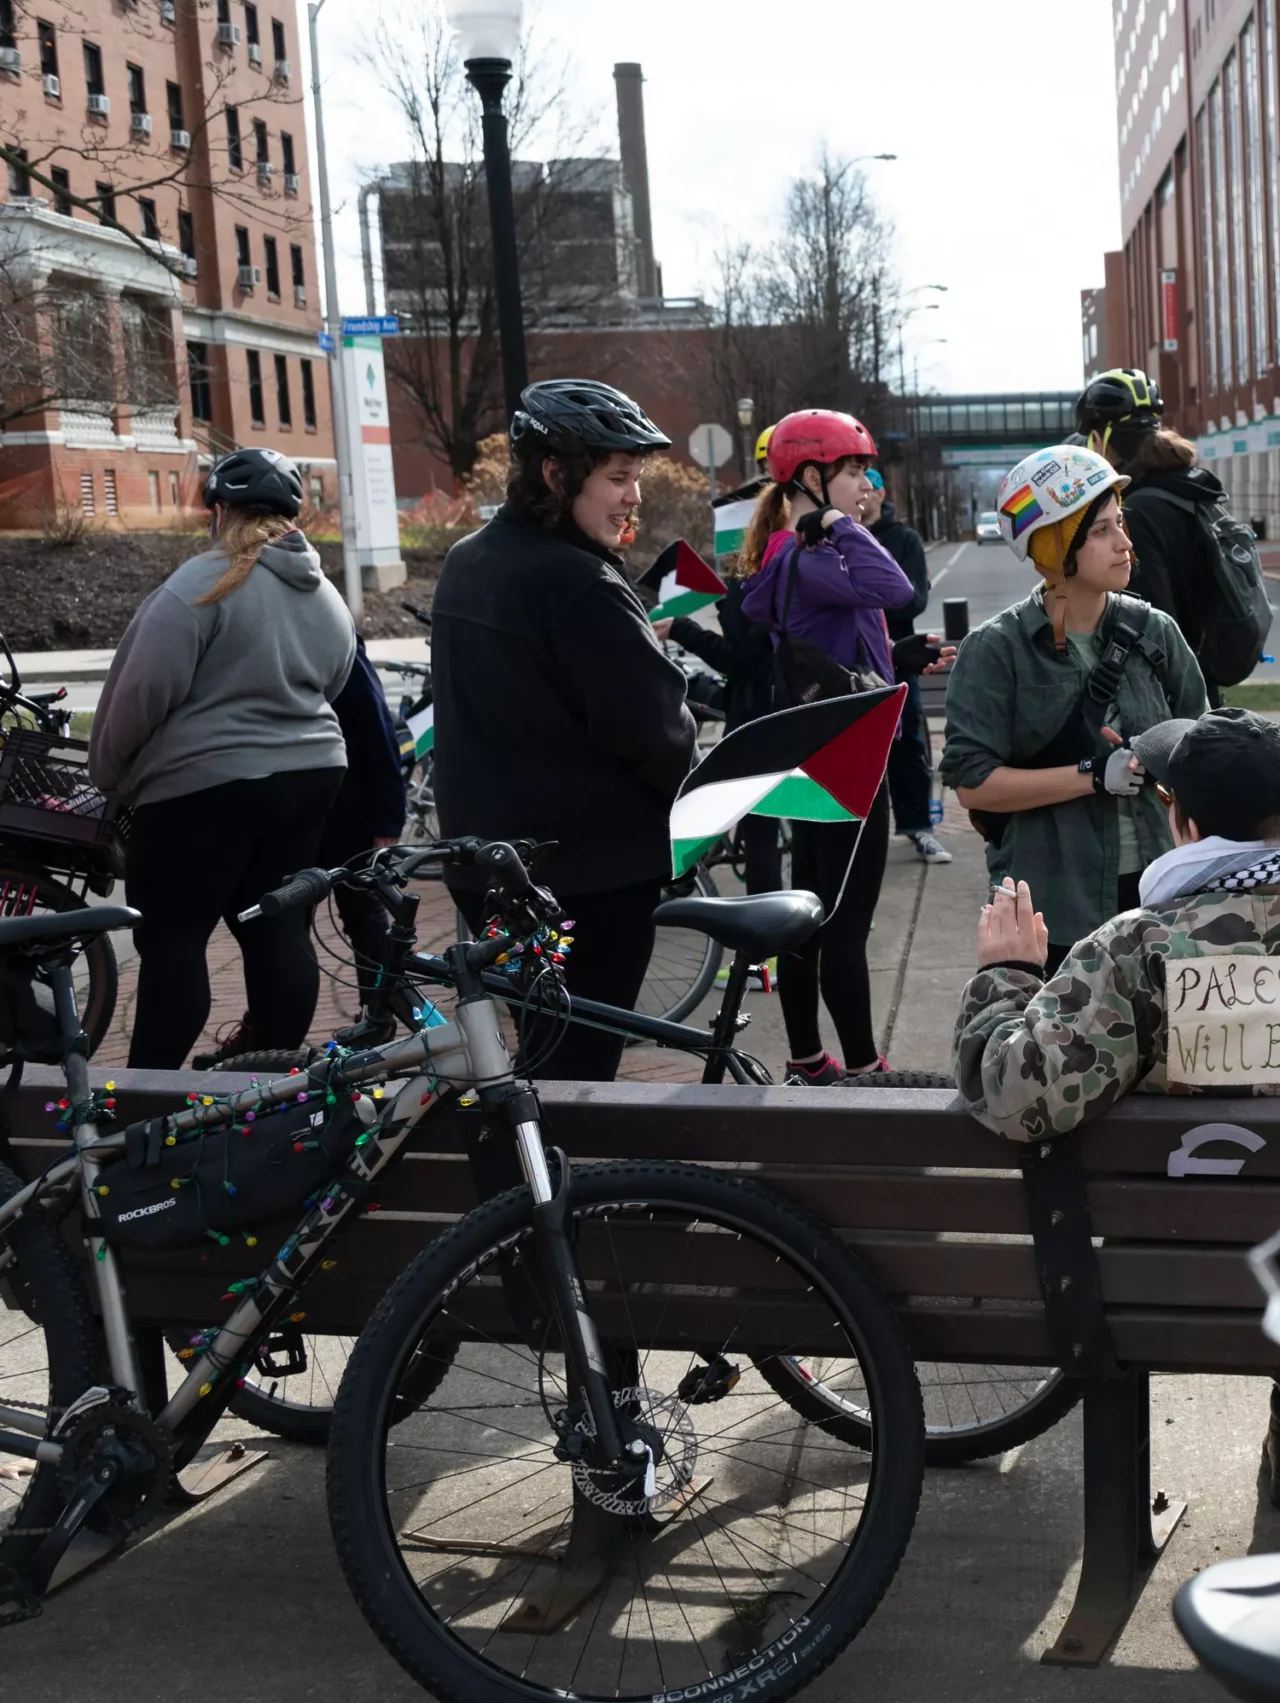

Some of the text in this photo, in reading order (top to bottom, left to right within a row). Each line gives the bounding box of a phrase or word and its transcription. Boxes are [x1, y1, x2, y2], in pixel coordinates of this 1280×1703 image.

[344, 319, 397, 334] Friendship Ave
[530, 419, 549, 435] KALI
[1172, 1023, 1252, 1073] Will
[118, 1197, 176, 1223] ROCKBROS
[665, 1615, 811, 1702] CONNECTION
[737, 1656, 793, 1700] XR2
